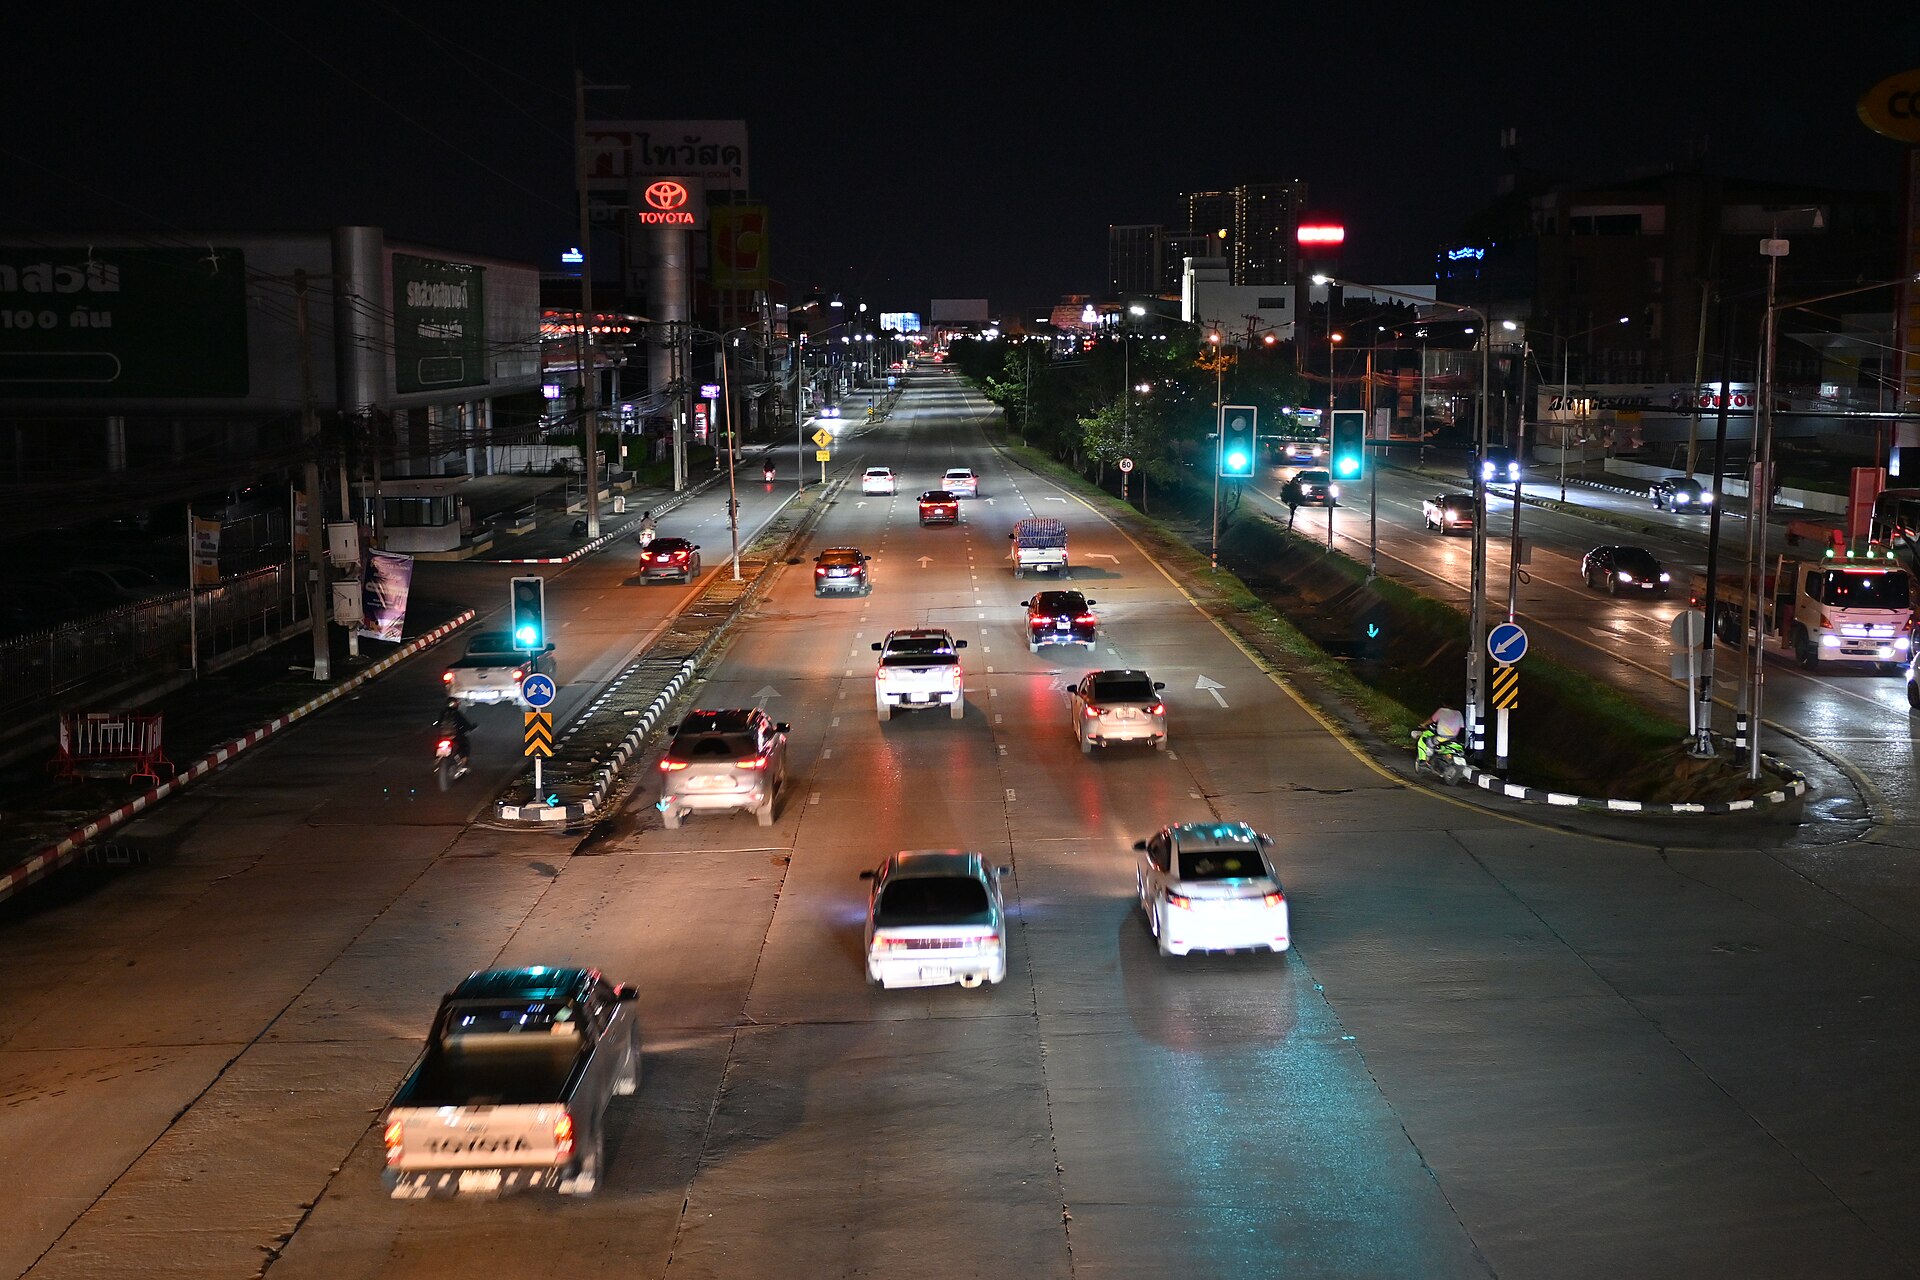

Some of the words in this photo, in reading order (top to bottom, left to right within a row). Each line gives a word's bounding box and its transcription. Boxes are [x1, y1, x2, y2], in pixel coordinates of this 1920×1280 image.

[636, 132, 742, 177] ไทวัสดุ
[639, 212, 694, 224] TOYOTA
[1548, 395, 1652, 411] BRGESTONE
